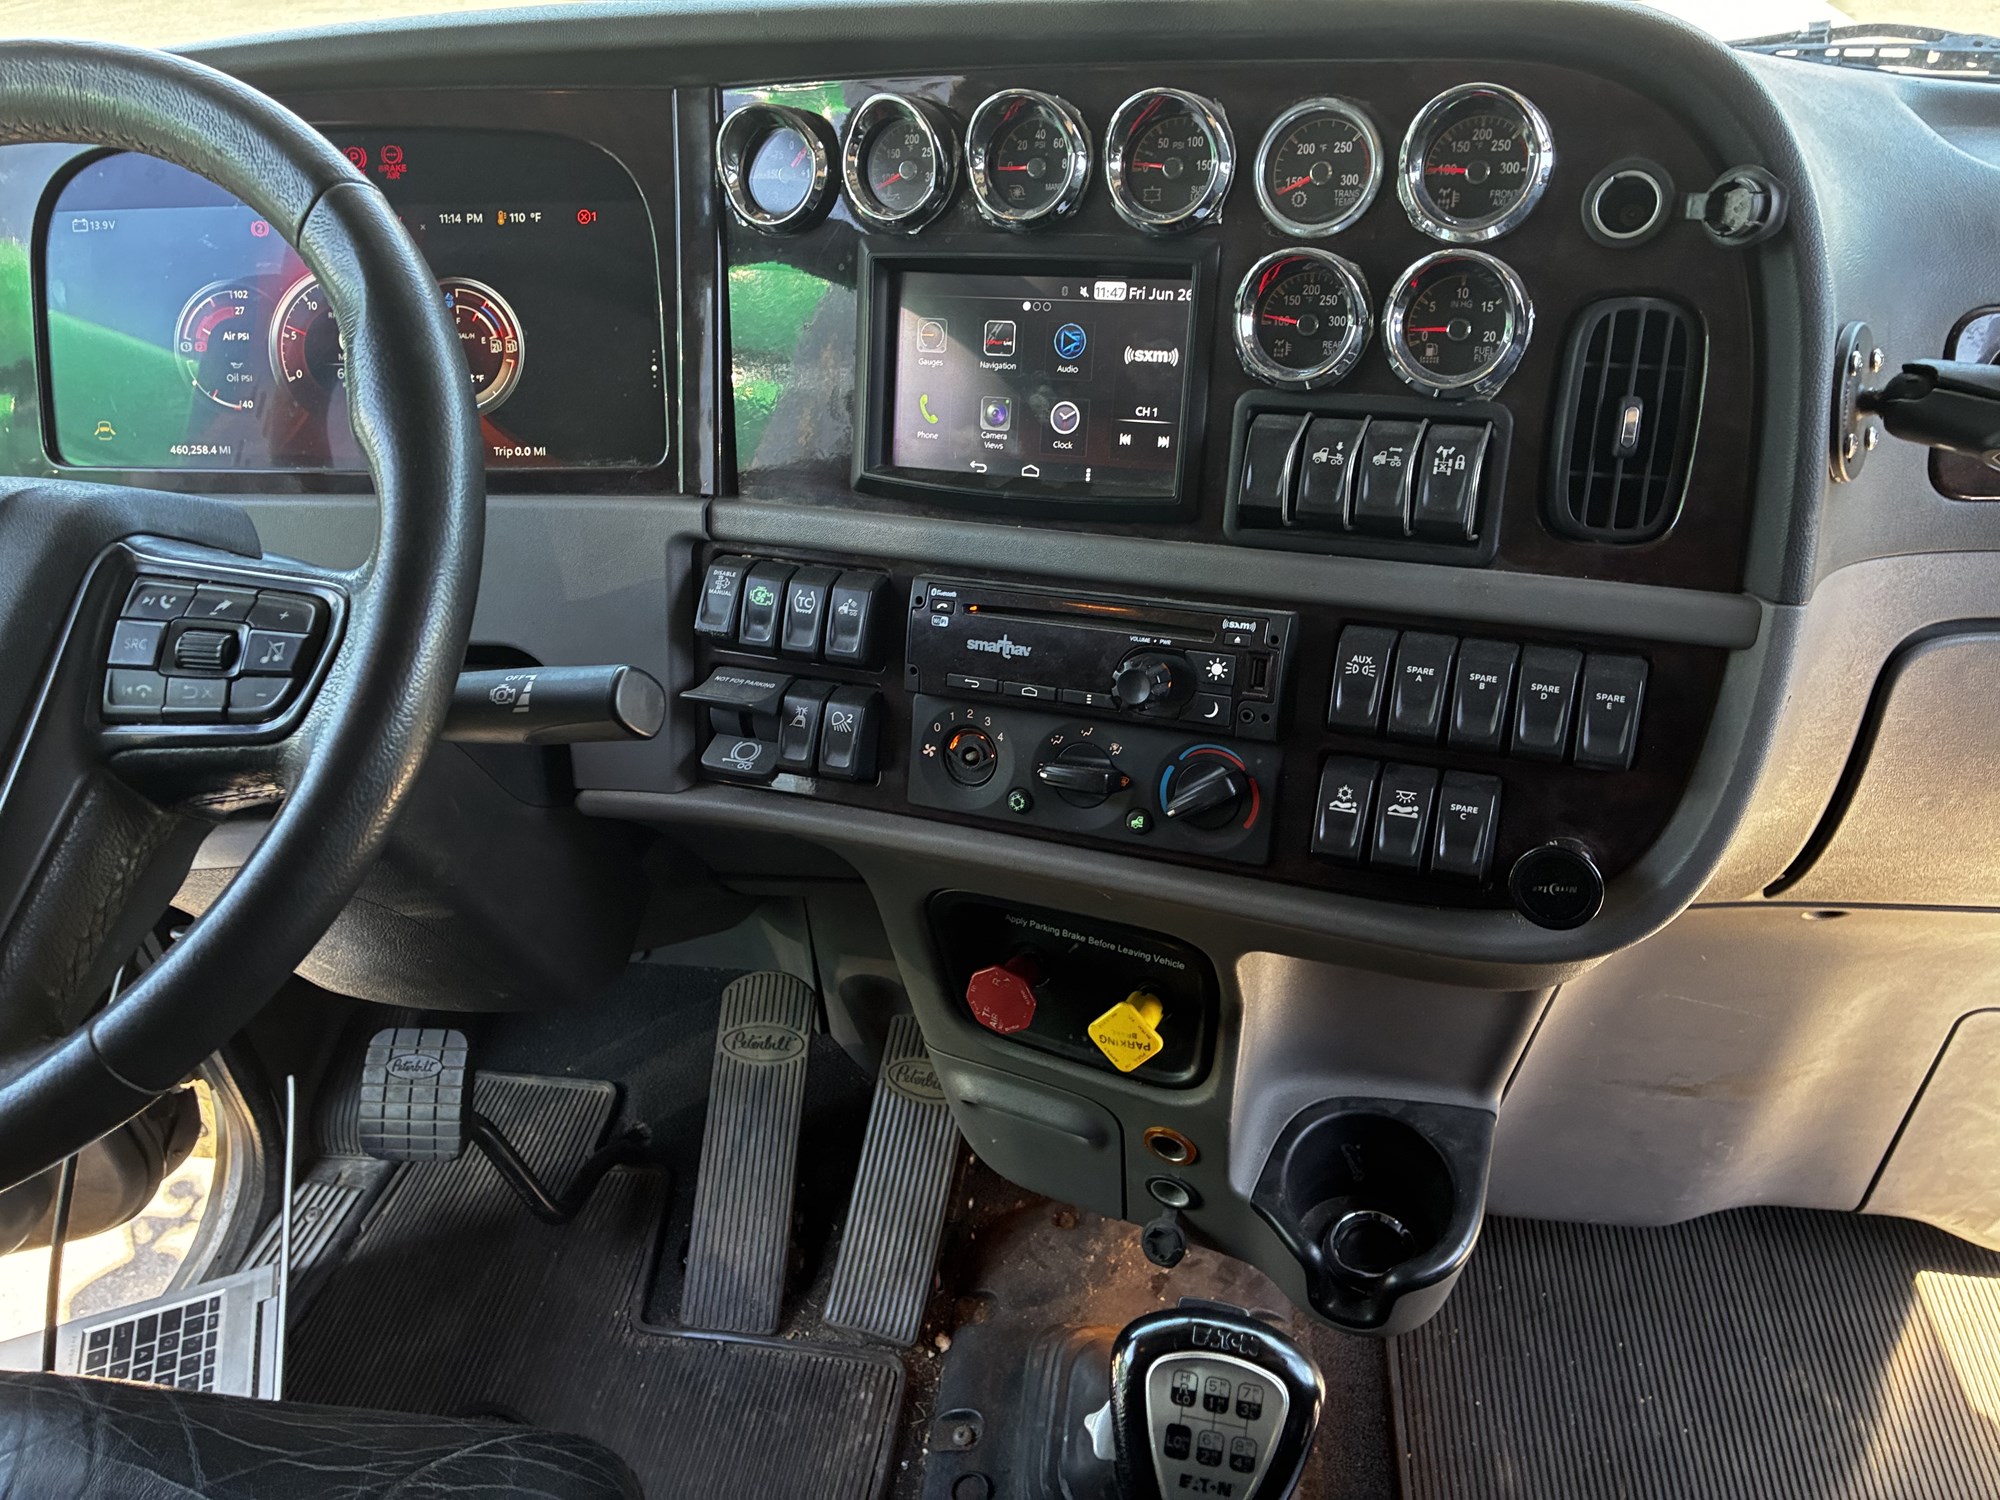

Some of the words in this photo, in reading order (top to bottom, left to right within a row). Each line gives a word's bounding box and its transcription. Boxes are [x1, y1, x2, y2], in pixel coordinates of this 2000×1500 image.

[904, 134, 920, 144] 200
[1035, 128, 1046, 140] 40
[1472, 128, 1492, 140] 200
[1017, 140, 1028, 150] 20
[1053, 138, 1064, 149] 60
[1158, 138, 1169, 148] 50
[1172, 141, 1184, 149] PSI
[1187, 136, 1204, 147] 100
[1492, 140, 1512, 152] 250
[1296, 143, 1316, 154] 200
[1334, 142, 1352, 154] 250
[1452, 142, 1470, 152] 150
[887, 148, 900, 158] 150
[922, 147, 932, 158] 25
[378, 164, 407, 172] BRAKE
[1196, 160, 1212, 170] 150
[1500, 162, 1520, 174] 300
[1340, 174, 1359, 186] 300
[1334, 190, 1360, 198] TRANS
[439, 214, 462, 224] 11:14
[466, 214, 483, 224] PM
[509, 212, 526, 222] 110
[530, 212, 542, 222] °F
[591, 212, 597, 222] 1
[90, 220, 116, 230] 13.9V
[234, 290, 248, 299] 102
[1096, 287, 1125, 298] 11:47
[1129, 286, 1146, 300] Fri
[1148, 288, 1174, 301] Jun
[1303, 284, 1320, 296] 200
[1456, 288, 1469, 298] 10
[1284, 294, 1300, 306] 150
[1320, 294, 1338, 306] 250
[1461, 300, 1472, 308] HG
[235, 306, 245, 315] 27
[306, 301, 318, 310] 10
[1429, 301, 1436, 312] 5
[1482, 301, 1494, 312] 15
[1328, 316, 1346, 327] 300
[222, 331, 236, 340] Air
[238, 332, 250, 340] PSI
[290, 331, 297, 340] 5
[1421, 330, 1428, 342] 0
[1483, 330, 1496, 342] 20
[1474, 346, 1494, 354] FUEL
[918, 358, 944, 368] Gauges
[980, 361, 1016, 372] Navigation
[296, 370, 302, 378] 0
[1056, 365, 1078, 374] Audio
[226, 374, 239, 382] Oil
[241, 374, 252, 382] PSI
[242, 400, 254, 408] 40
[1135, 407, 1151, 416] CH
[1152, 408, 1158, 417] 1
[917, 431, 938, 440] Phone
[980, 432, 1008, 440] Camera
[984, 441, 1004, 450] Views
[1052, 440, 1073, 450] Clock
[170, 446, 217, 456] 460,258.4
[220, 446, 231, 454] MI
[494, 446, 513, 458] Trip
[514, 446, 531, 456] 0.0
[534, 446, 546, 456] MI
[714, 569, 737, 578] DISABLE
[708, 588, 732, 596] MANUAL
[798, 596, 812, 608] TC
[124, 638, 147, 650] SRC
[1130, 636, 1150, 644] VOLUME
[1159, 638, 1172, 646] PWR
[966, 634, 1032, 659] smartnav
[1352, 655, 1373, 664] AUX
[1406, 666, 1434, 676] SPARE
[714, 675, 730, 684] NOT
[746, 680, 775, 689] PARKING
[1470, 673, 1498, 684] SPARE
[1478, 682, 1486, 690] B
[1531, 683, 1560, 694] SPARE
[1540, 692, 1548, 700] D
[1596, 692, 1626, 704] SPARE
[1606, 702, 1613, 710] E
[950, 712, 954, 720] 1
[966, 709, 974, 718] 2
[847, 714, 854, 724] 2
[984, 716, 992, 726] 3
[934, 722, 941, 732] 0
[996, 732, 1004, 742] 4
[1450, 804, 1478, 814] SPARE
[1460, 812, 1468, 821] C
[1005, 914, 1028, 928] Apply
[1030, 920, 1060, 936] Parking
[1062, 929, 1086, 942] Brake
[1088, 936, 1116, 951] Before
[1118, 944, 1151, 962] Leaving
[1152, 954, 1185, 970] Vehicle
[732, 1031, 797, 1050] Peterbilt
[1099, 1034, 1151, 1052] PARKING
[164, 1338, 173, 1347] Q
[138, 1350, 148, 1358] A
[1209, 1380, 1217, 1392] 5
[1243, 1386, 1252, 1398] 7
[1176, 1396, 1190, 1405] LO
[1241, 1404, 1248, 1416] 3
[1202, 1434, 1210, 1445] 6
[1236, 1440, 1244, 1452] 8
